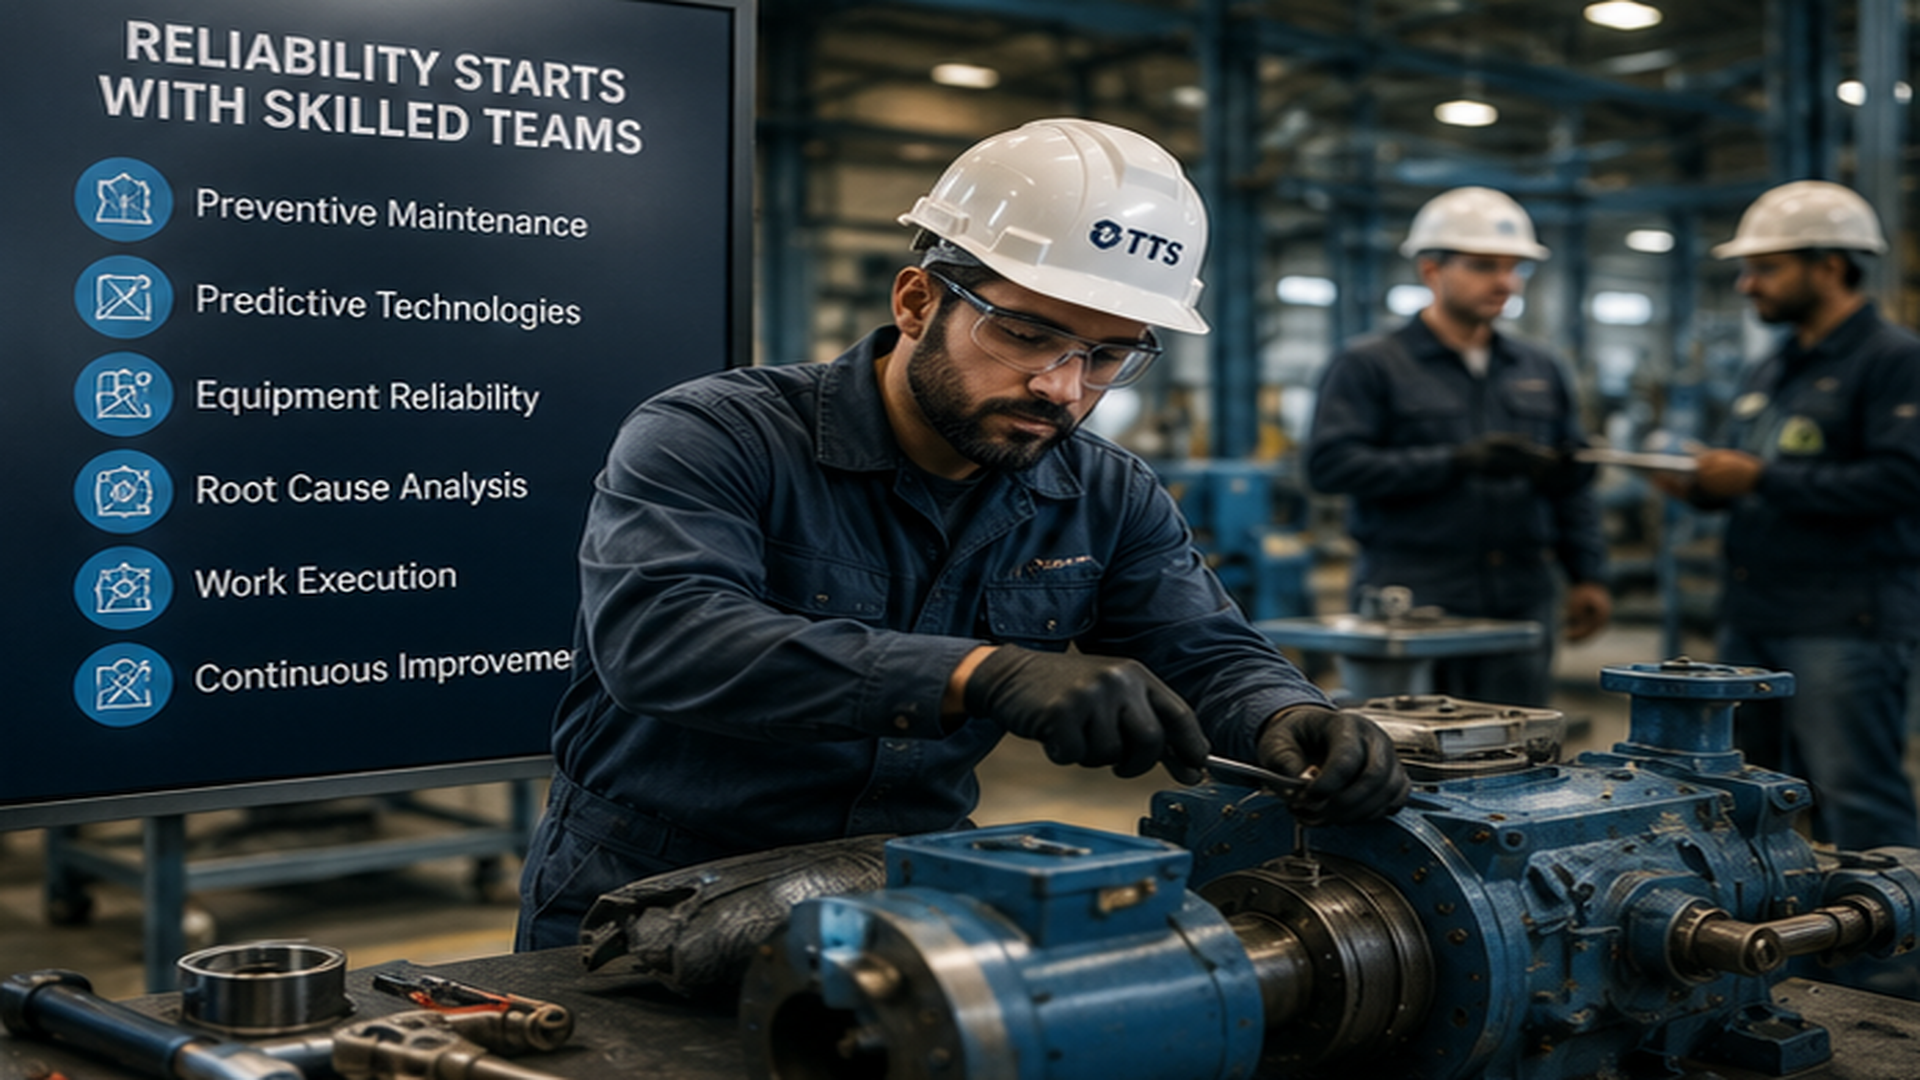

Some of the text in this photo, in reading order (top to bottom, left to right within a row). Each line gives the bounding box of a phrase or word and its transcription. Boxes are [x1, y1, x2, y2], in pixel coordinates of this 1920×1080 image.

[127, 21, 626, 103] RELIABILITY STARTS
[99, 75, 643, 155] WITH SKILLED TEAMS
[197, 189, 589, 238] Preventive Maintenance
[1127, 228, 1183, 266] TTS
[197, 284, 581, 331] Predictive Technologies
[197, 379, 540, 418] Equipment Reliability
[197, 471, 528, 506] Root Cause Analysis
[195, 562, 457, 598] Work Execution
[195, 648, 577, 693] Continuous Improveme
